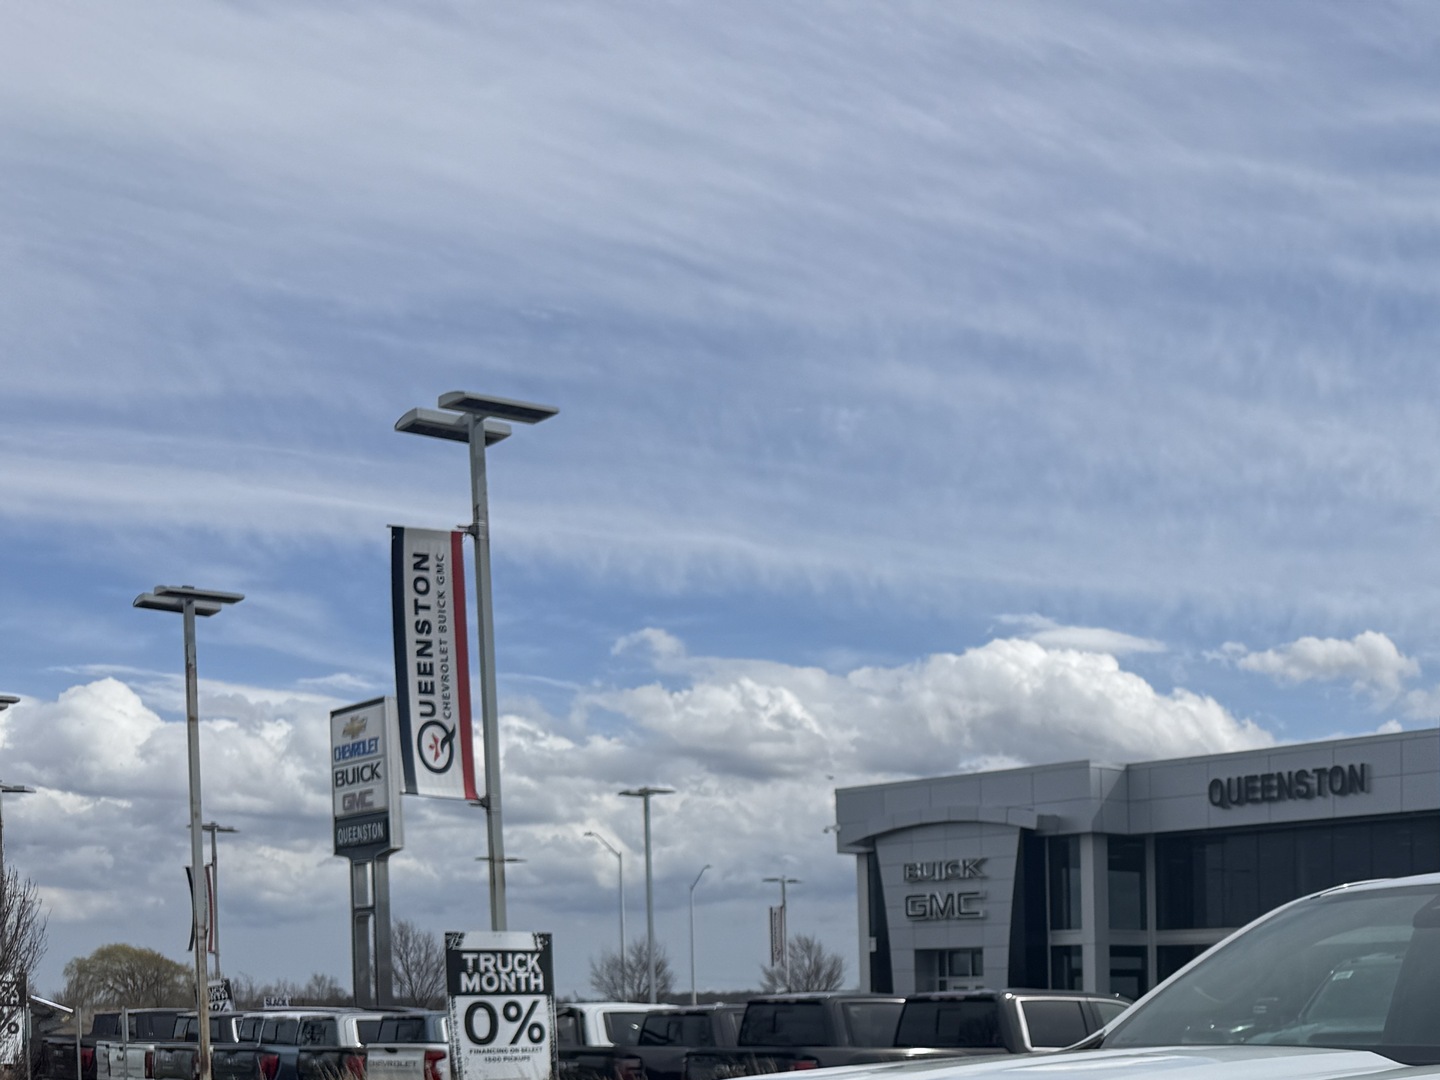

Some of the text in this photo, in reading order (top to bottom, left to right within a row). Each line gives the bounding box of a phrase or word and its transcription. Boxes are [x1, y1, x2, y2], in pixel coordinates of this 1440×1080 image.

[435, 553, 452, 721] CHEVROLET BUICK GMC
[412, 552, 456, 775] QUEENSTON
[333, 736, 380, 762] CHEVROLET
[334, 760, 382, 788] BUICK
[1208, 763, 1370, 809] QUEENSTON
[341, 787, 375, 811] GMC
[336, 822, 384, 845] QUEENSTON
[903, 857, 990, 883] BUICK
[905, 891, 987, 921] GMC
[461, 952, 542, 974] TRUCK
[460, 972, 545, 993] MONTH
[464, 1000, 547, 1046] 0%
[469, 1047, 509, 1055] FINANCING
[520, 1046, 543, 1054] SELECT
